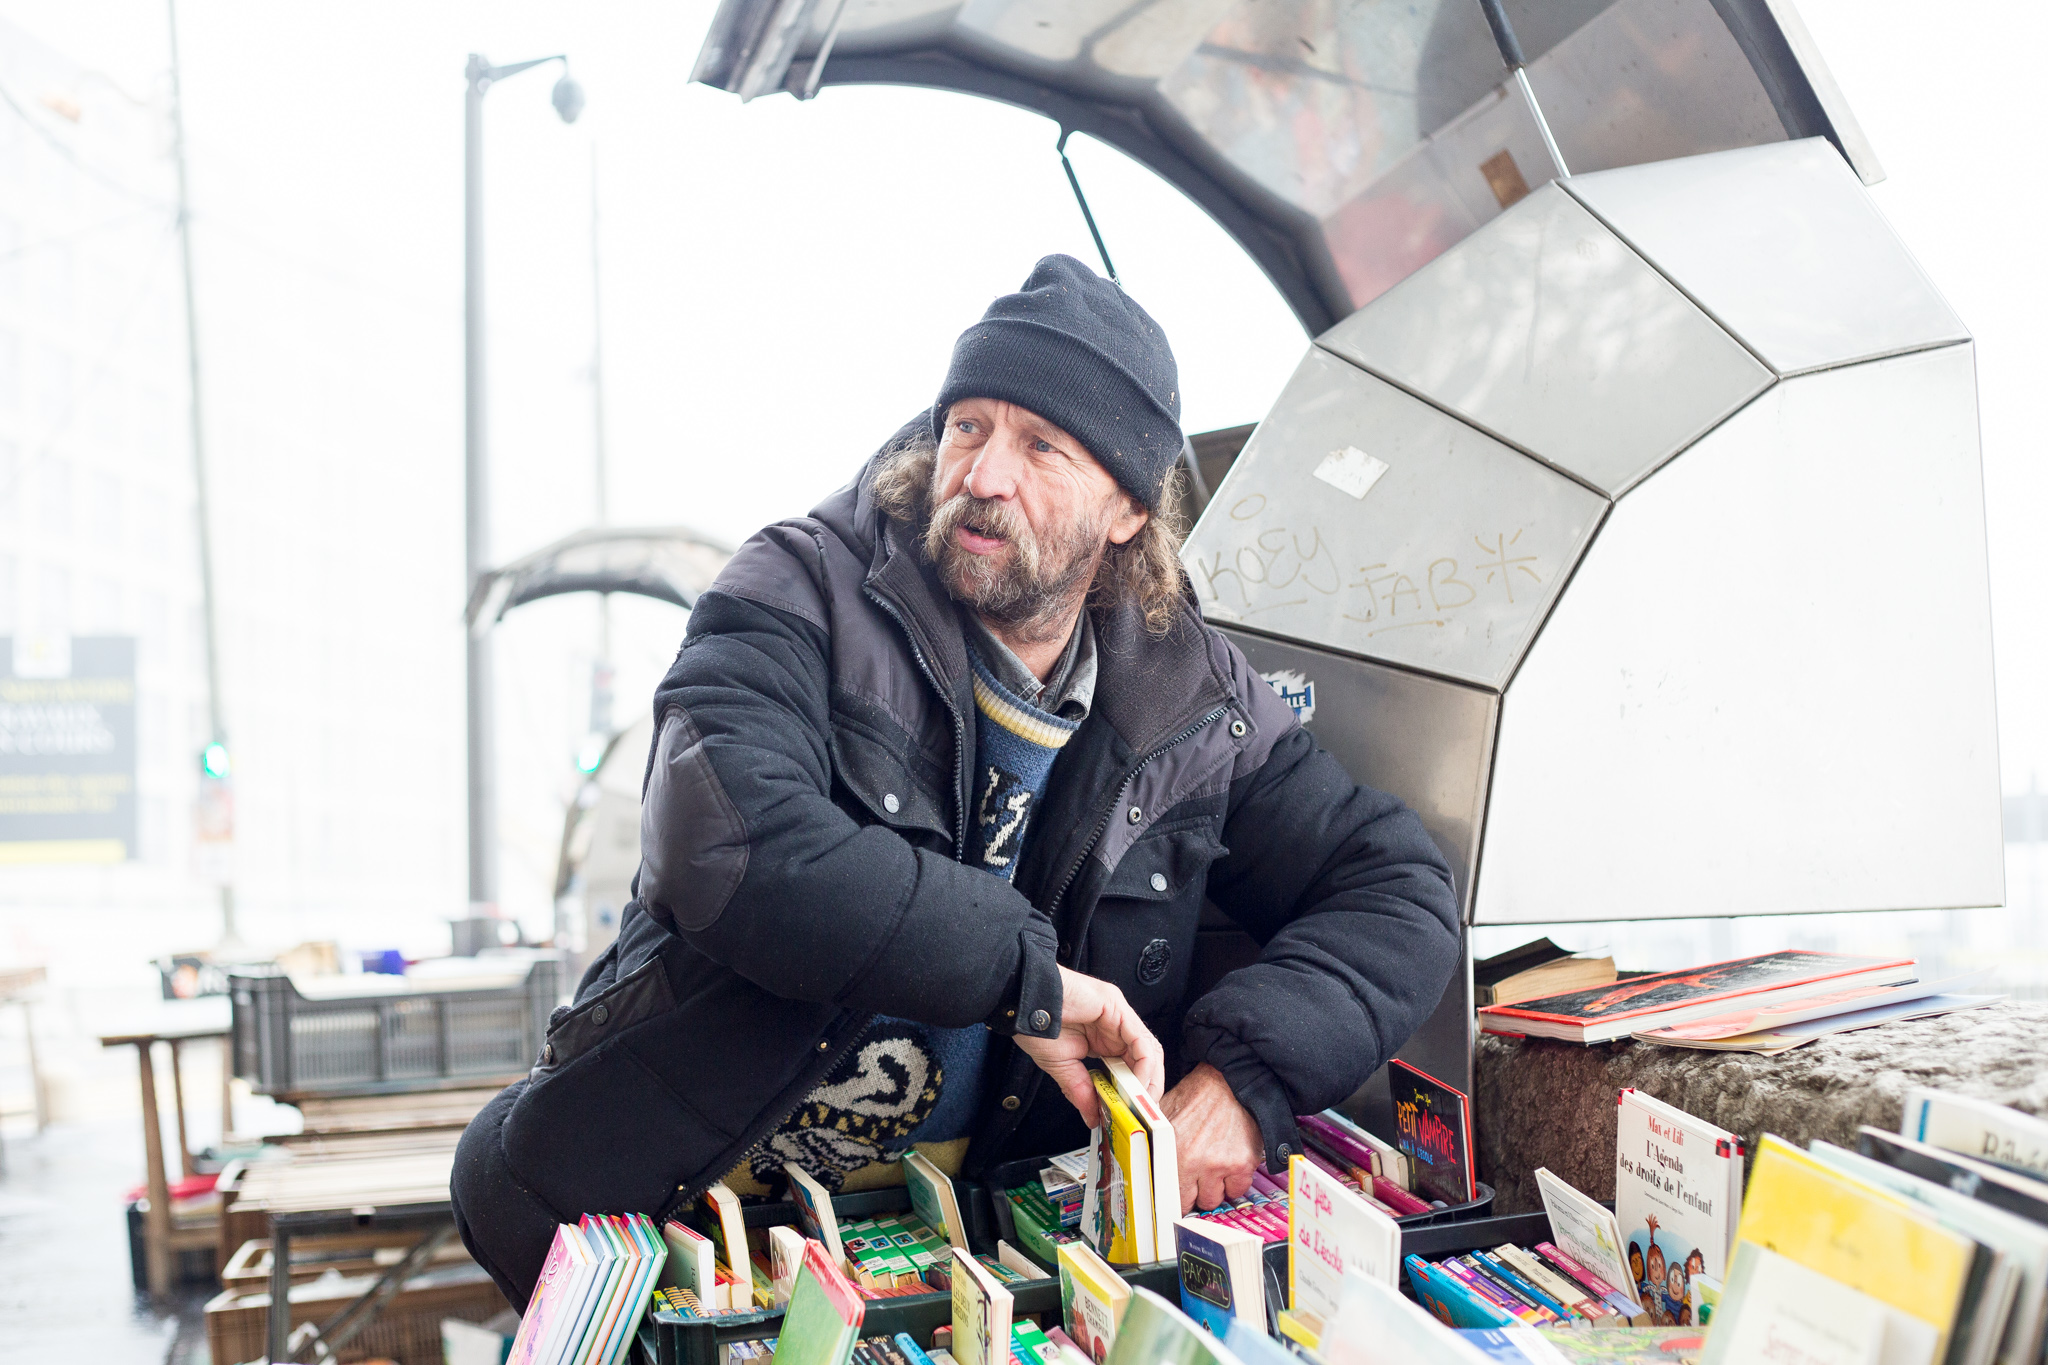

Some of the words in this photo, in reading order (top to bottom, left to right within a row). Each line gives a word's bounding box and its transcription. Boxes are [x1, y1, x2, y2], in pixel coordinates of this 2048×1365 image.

[1396, 1100, 1418, 1140] PETIT
[1417, 1108, 1457, 1165] VAMPIRE
[1647, 1114, 1662, 1137] Max
[1663, 1126, 1671, 1141] et
[1672, 1127, 1685, 1147] Lili
[1645, 1139, 1684, 1175] L'Agenda
[1299, 1170, 1312, 1200] La
[1314, 1182, 1333, 1219] fête
[1619, 1152, 1634, 1175] des
[1635, 1162, 1662, 1190] droits
[1664, 1176, 1675, 1196] de
[1677, 1179, 1713, 1218] l'enfant
[1298, 1223, 1311, 1249] de
[1182, 1257, 1229, 1301] PAKKAL
[1084, 1295, 1108, 1328] BENNETT
[1086, 1311, 1110, 1340] CHAMPION
